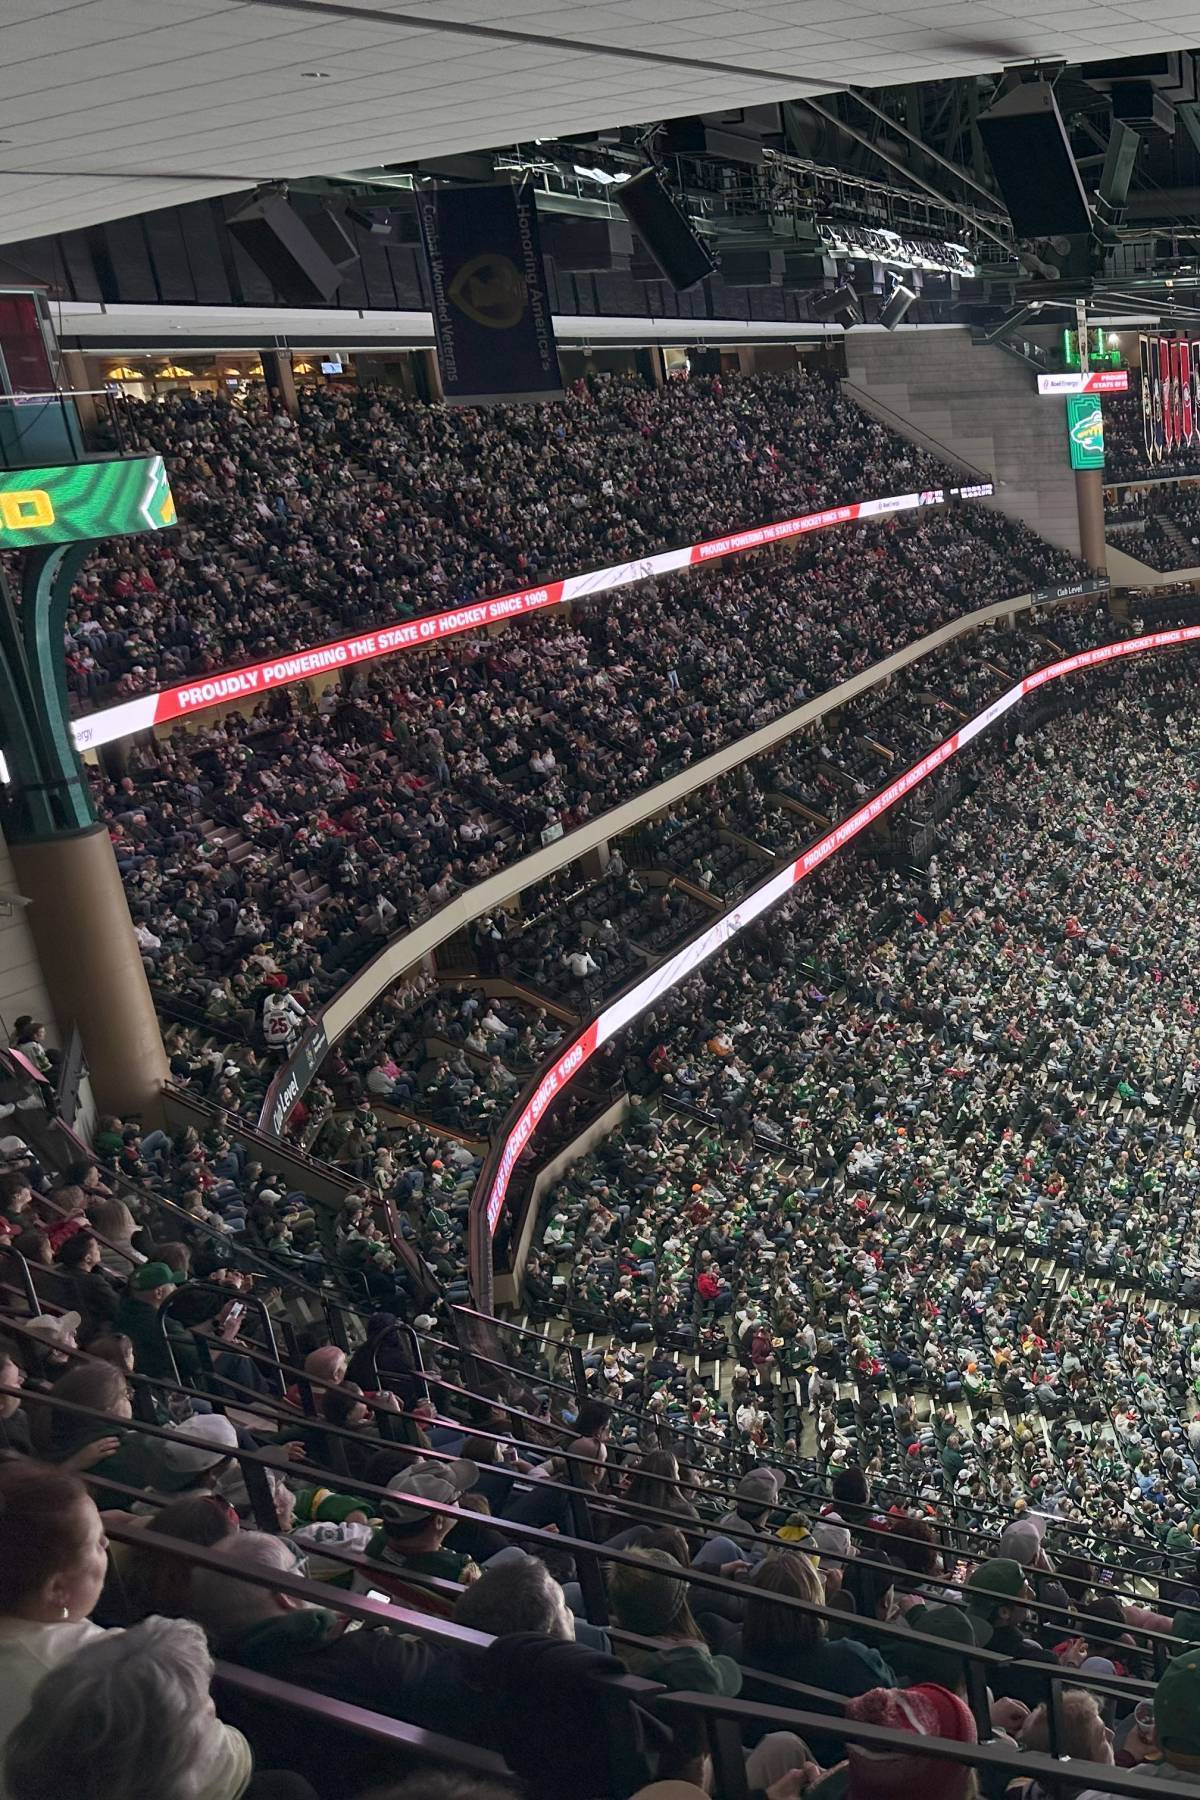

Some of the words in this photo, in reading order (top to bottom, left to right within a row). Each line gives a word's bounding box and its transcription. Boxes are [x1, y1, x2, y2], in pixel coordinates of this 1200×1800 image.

[423, 204, 440, 261] Combat
[432, 261, 449, 323] Wounded
[516, 203, 538, 284] Honoring
[529, 288, 549, 372] America's
[440, 325, 458, 382] Veterans
[1057, 588, 1068, 597] Club
[1068, 584, 1083, 595] Level
[178, 671, 259, 709] PROUDLY
[263, 645, 348, 683] POWERING
[348, 638, 375, 659] THE
[379, 626, 419, 649] STATE
[421, 620, 437, 637] OF
[440, 607, 488, 631] HOCKEY
[490, 598, 523, 616] SINCE
[524, 590, 549, 608] 1909
[269, 1018, 289, 1035] 25
[279, 1071, 300, 1113] Level
[531, 1076, 559, 1118] SINCE
[558, 1045, 584, 1079] 1909
